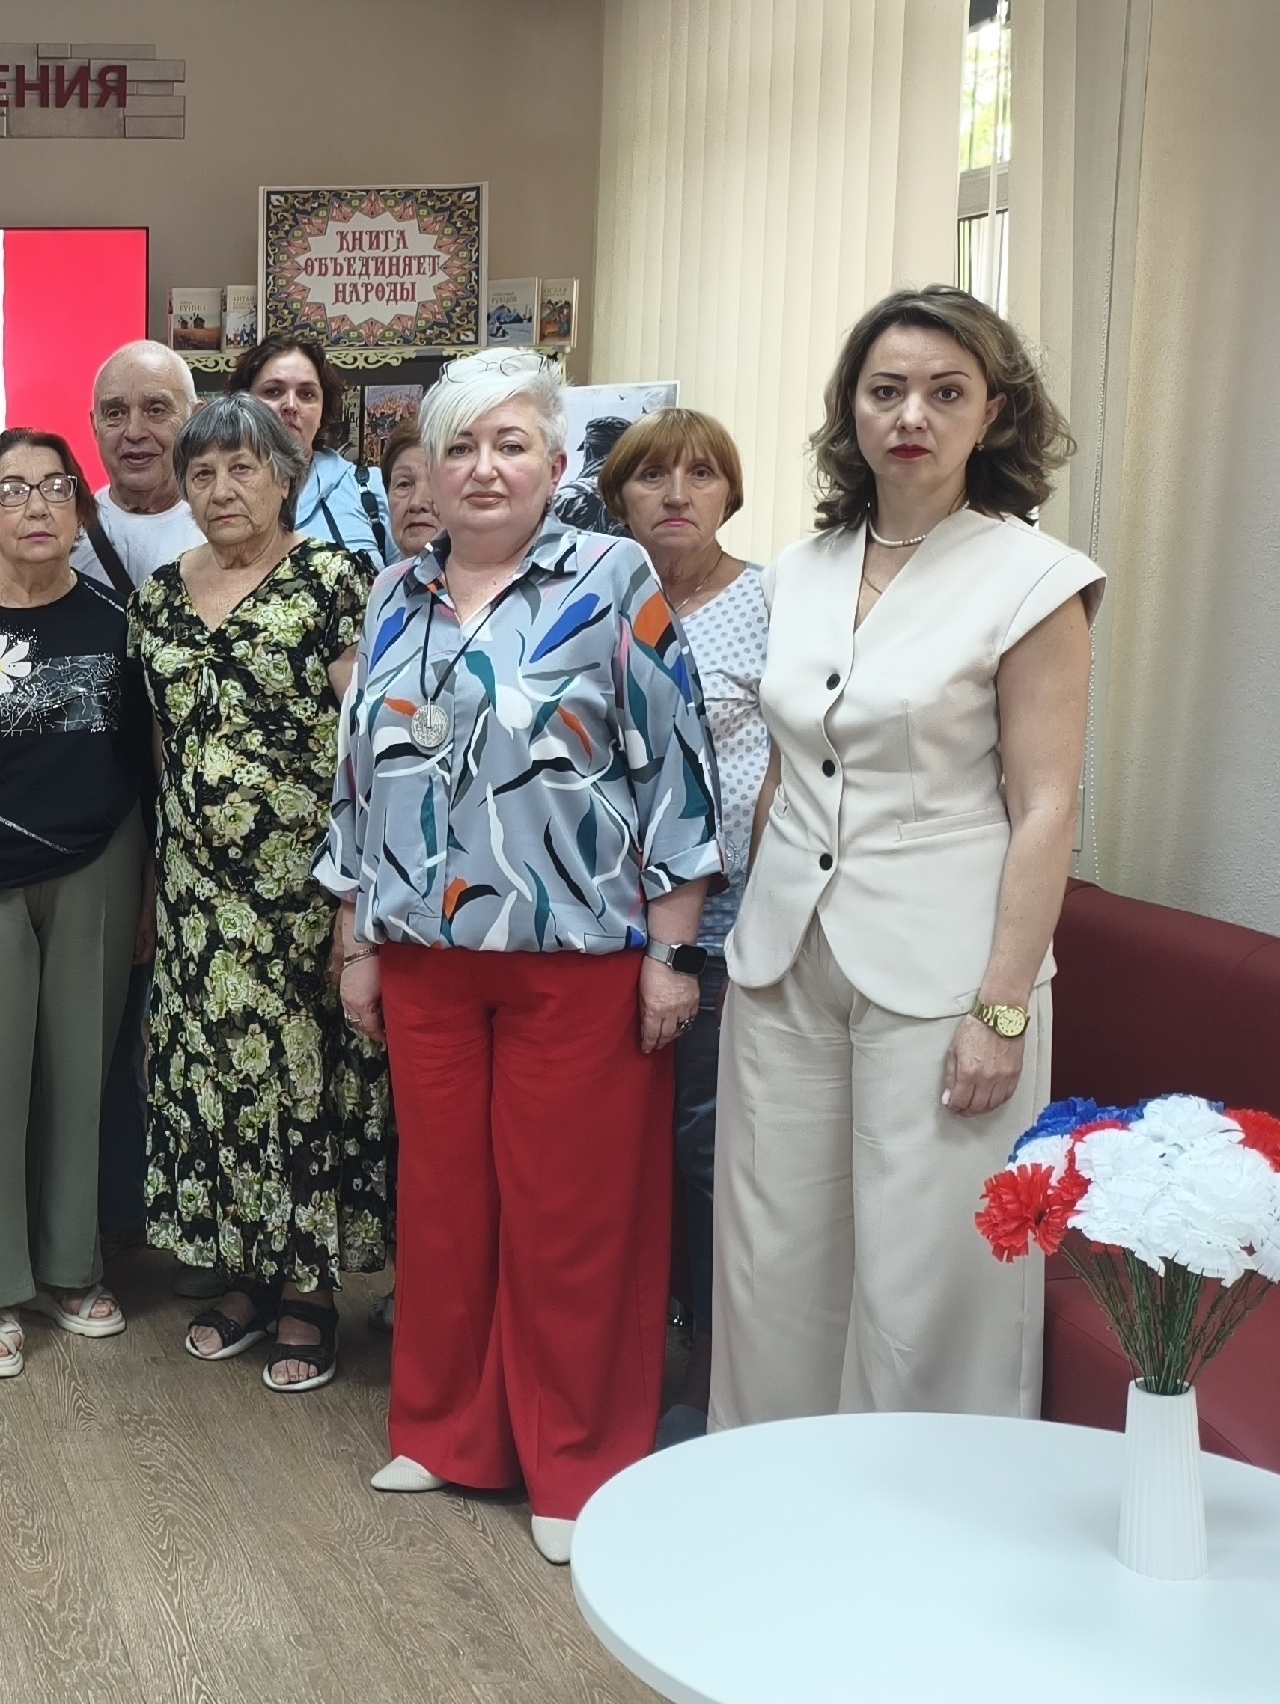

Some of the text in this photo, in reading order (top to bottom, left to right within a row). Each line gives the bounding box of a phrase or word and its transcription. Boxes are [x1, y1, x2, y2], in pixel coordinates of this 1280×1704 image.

[335, 229, 409, 253] КНИГА
[303, 255, 441, 279] ОБЪЕДИНЯЕТ
[331, 282, 417, 306] НАРОДЫ
